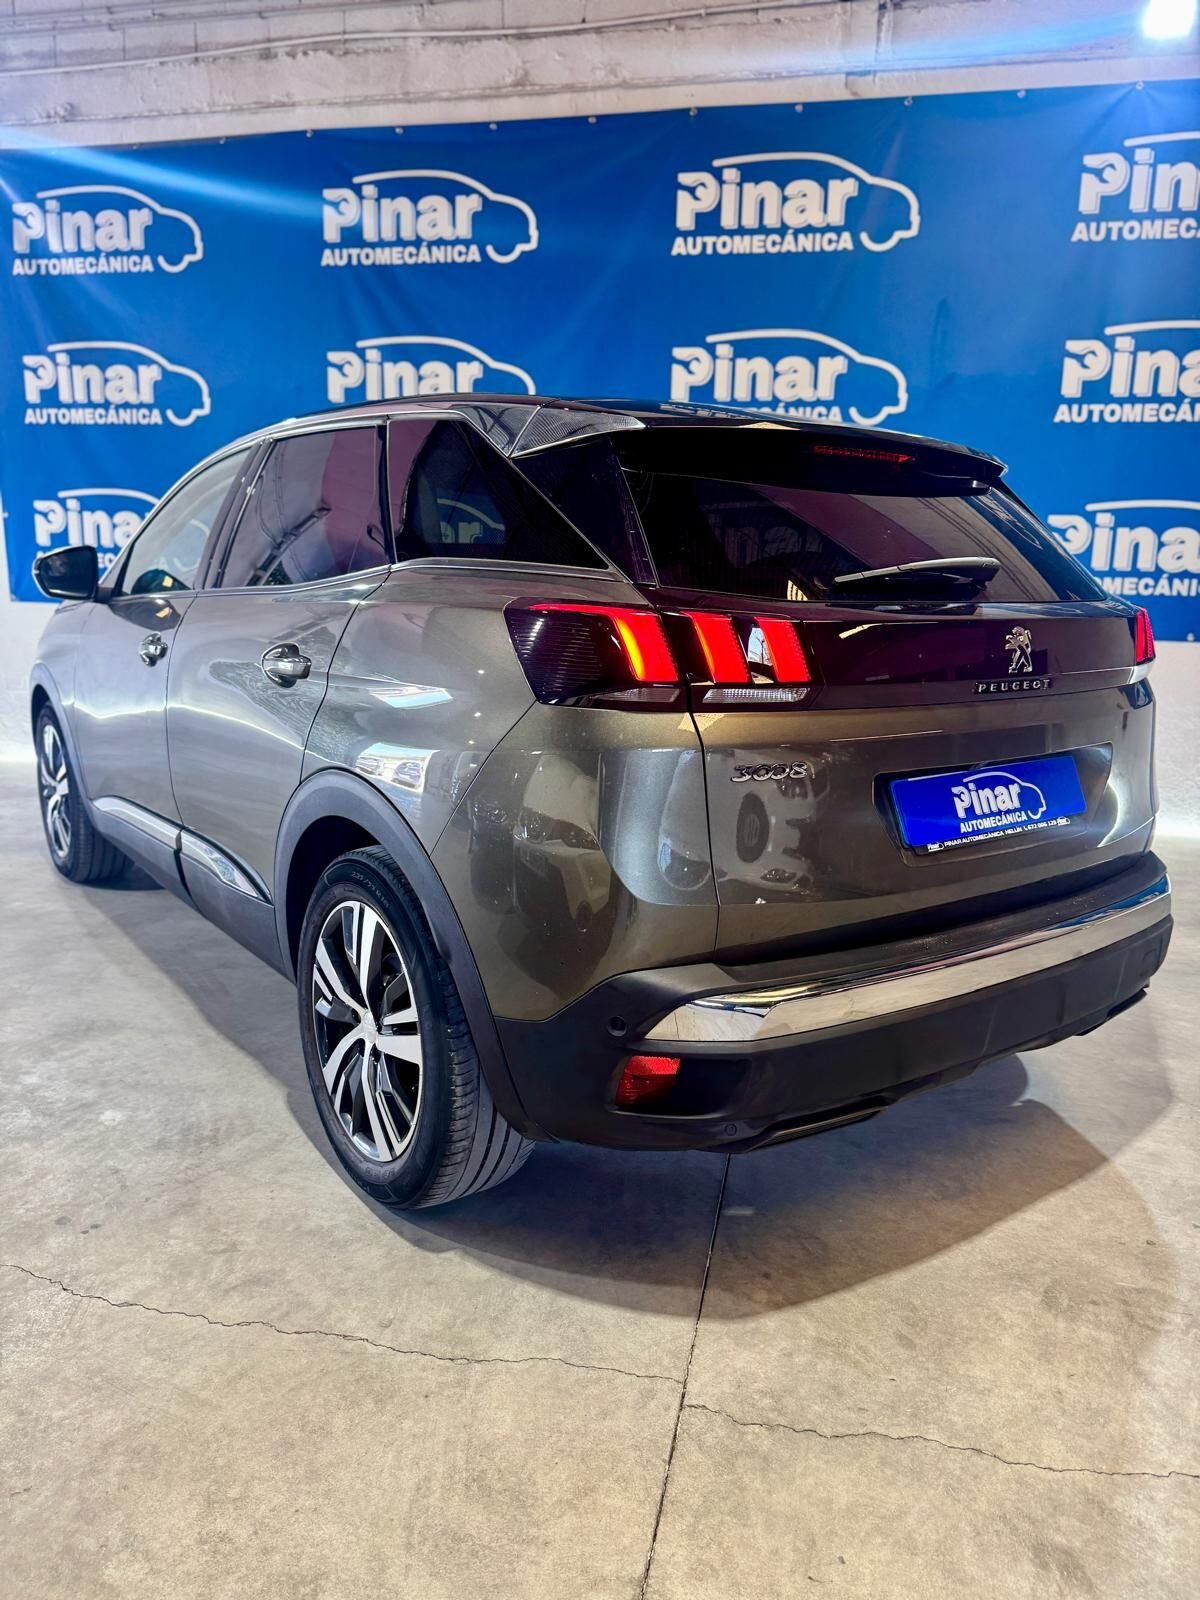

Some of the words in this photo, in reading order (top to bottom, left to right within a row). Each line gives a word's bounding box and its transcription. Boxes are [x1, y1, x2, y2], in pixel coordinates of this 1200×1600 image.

[676, 167, 858, 230] Pinar
[12, 200, 153, 253] Pinar
[322, 184, 483, 243] Pinar
[671, 229, 854, 257] AUTOMECÁNICA
[1071, 218, 1200, 242] AUTOMEC
[12, 252, 154, 276] AUTOMECÁNICA
[321, 241, 481, 267] AUTOMECÁNICA
[23, 352, 162, 405] Pinar
[326, 348, 484, 403] Pinar
[670, 343, 848, 403] Pinar
[24, 404, 164, 426] AUTOMECÁNICA
[33, 498, 142, 548] Pina
[978, 680, 1050, 693] PEUGEOT
[730, 762, 807, 782] 3008
[951, 782, 1022, 819] Pinar
[960, 812, 1028, 833] AUTOMECÁNICA
[944, 838, 963, 847] PINAR
